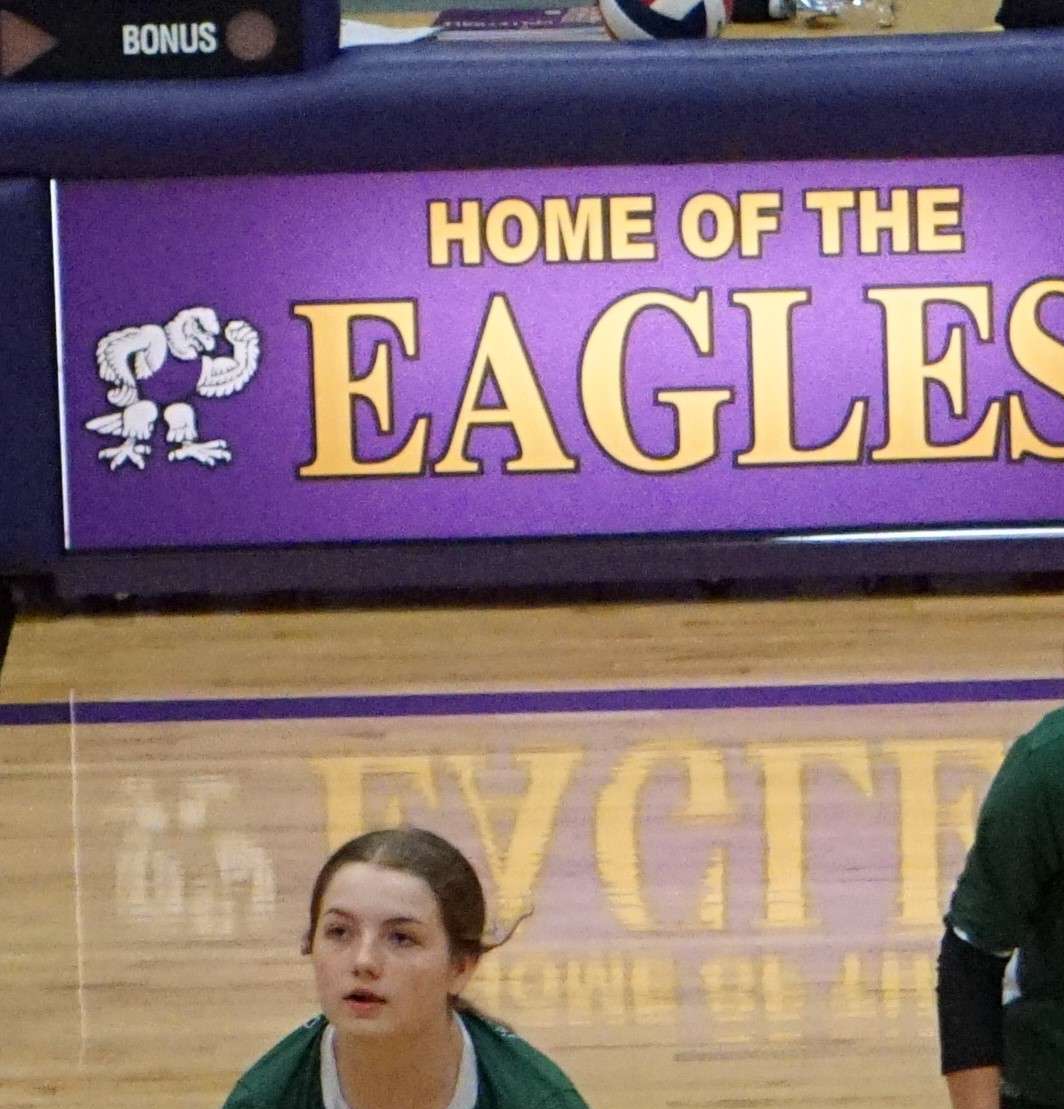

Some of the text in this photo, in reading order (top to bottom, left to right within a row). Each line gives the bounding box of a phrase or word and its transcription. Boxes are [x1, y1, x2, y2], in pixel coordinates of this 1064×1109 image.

[121, 22, 219, 56] BONUS
[427, 185, 966, 268] HOME OF THE
